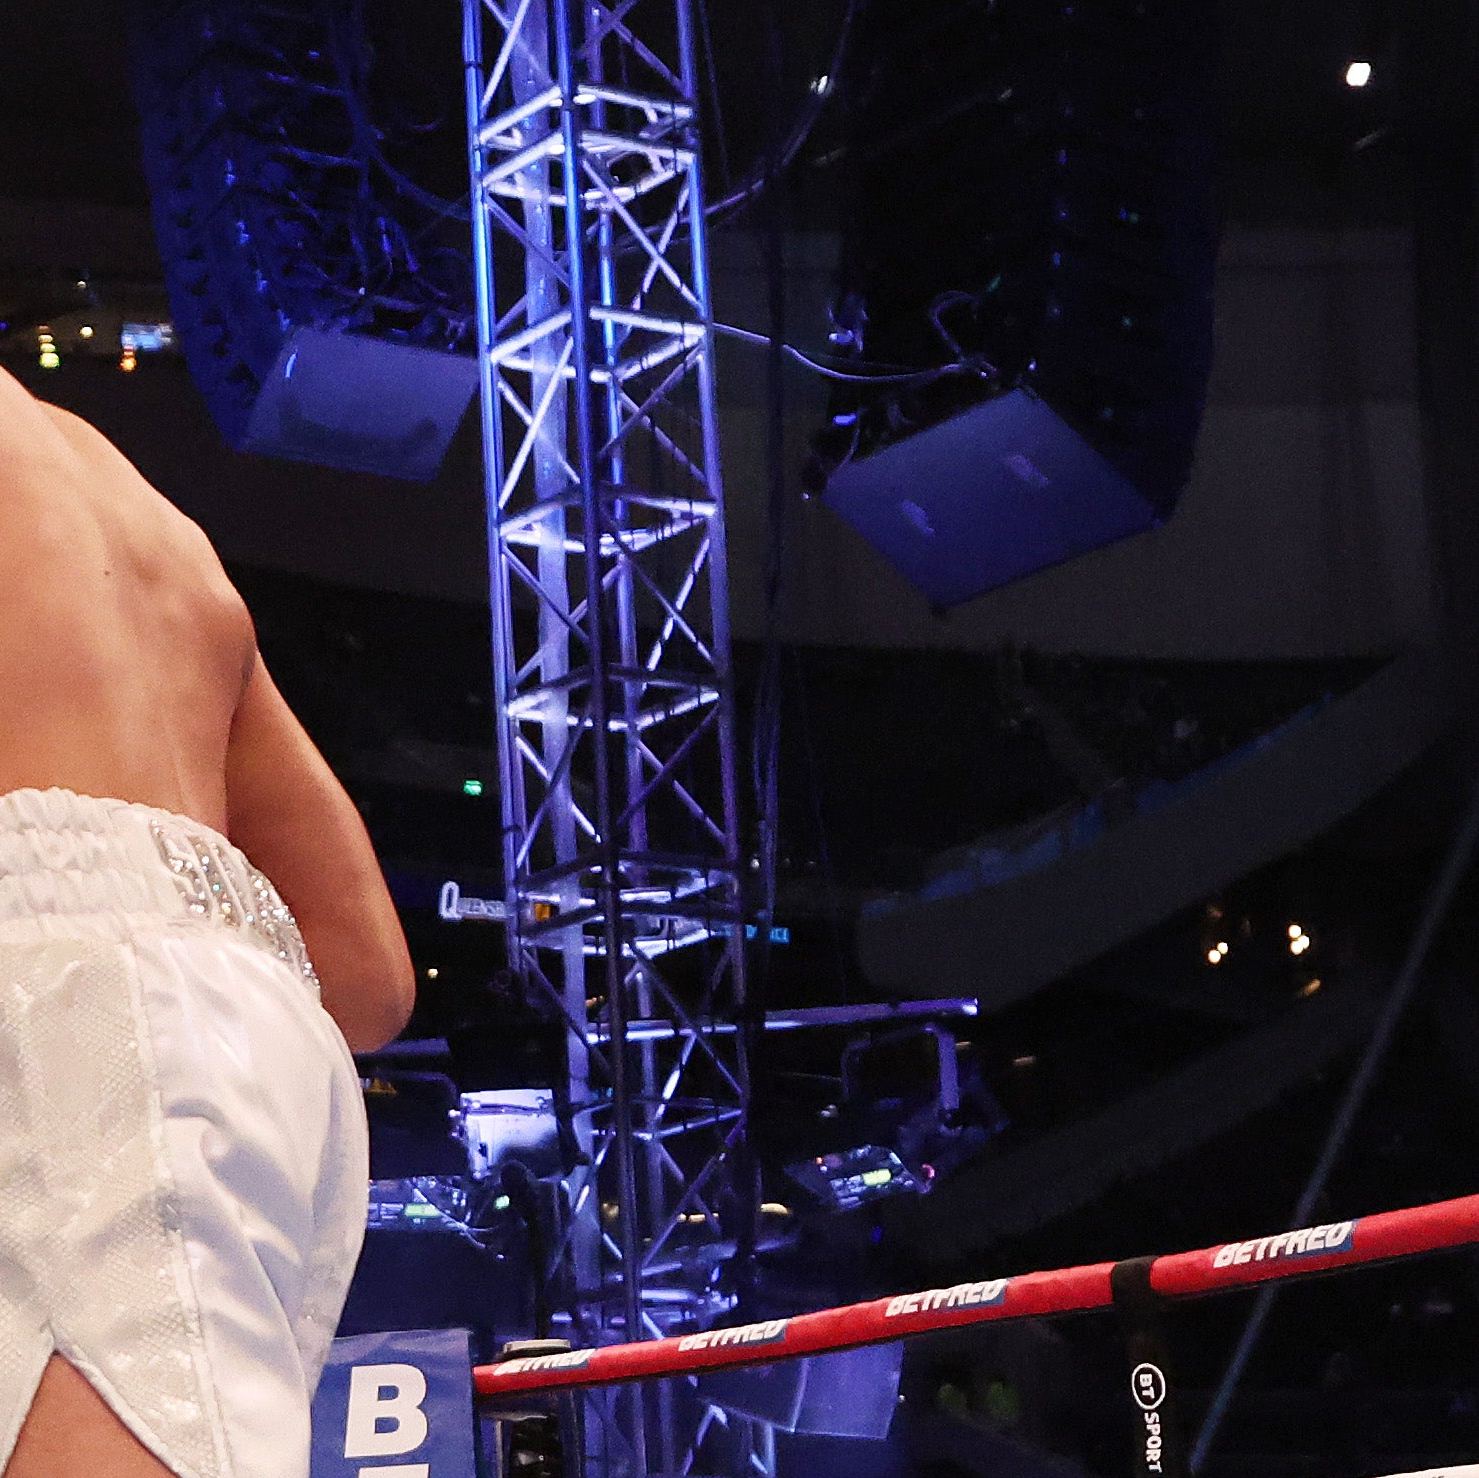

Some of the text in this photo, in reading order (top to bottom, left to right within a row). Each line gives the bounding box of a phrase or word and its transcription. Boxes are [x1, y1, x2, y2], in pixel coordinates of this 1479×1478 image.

[1213, 1221, 1353, 1269] BETFRED
[885, 1279, 1007, 1317] BETFRED
[1140, 1374, 1155, 1400] BT
[1144, 1411, 1163, 1475] SPORT
